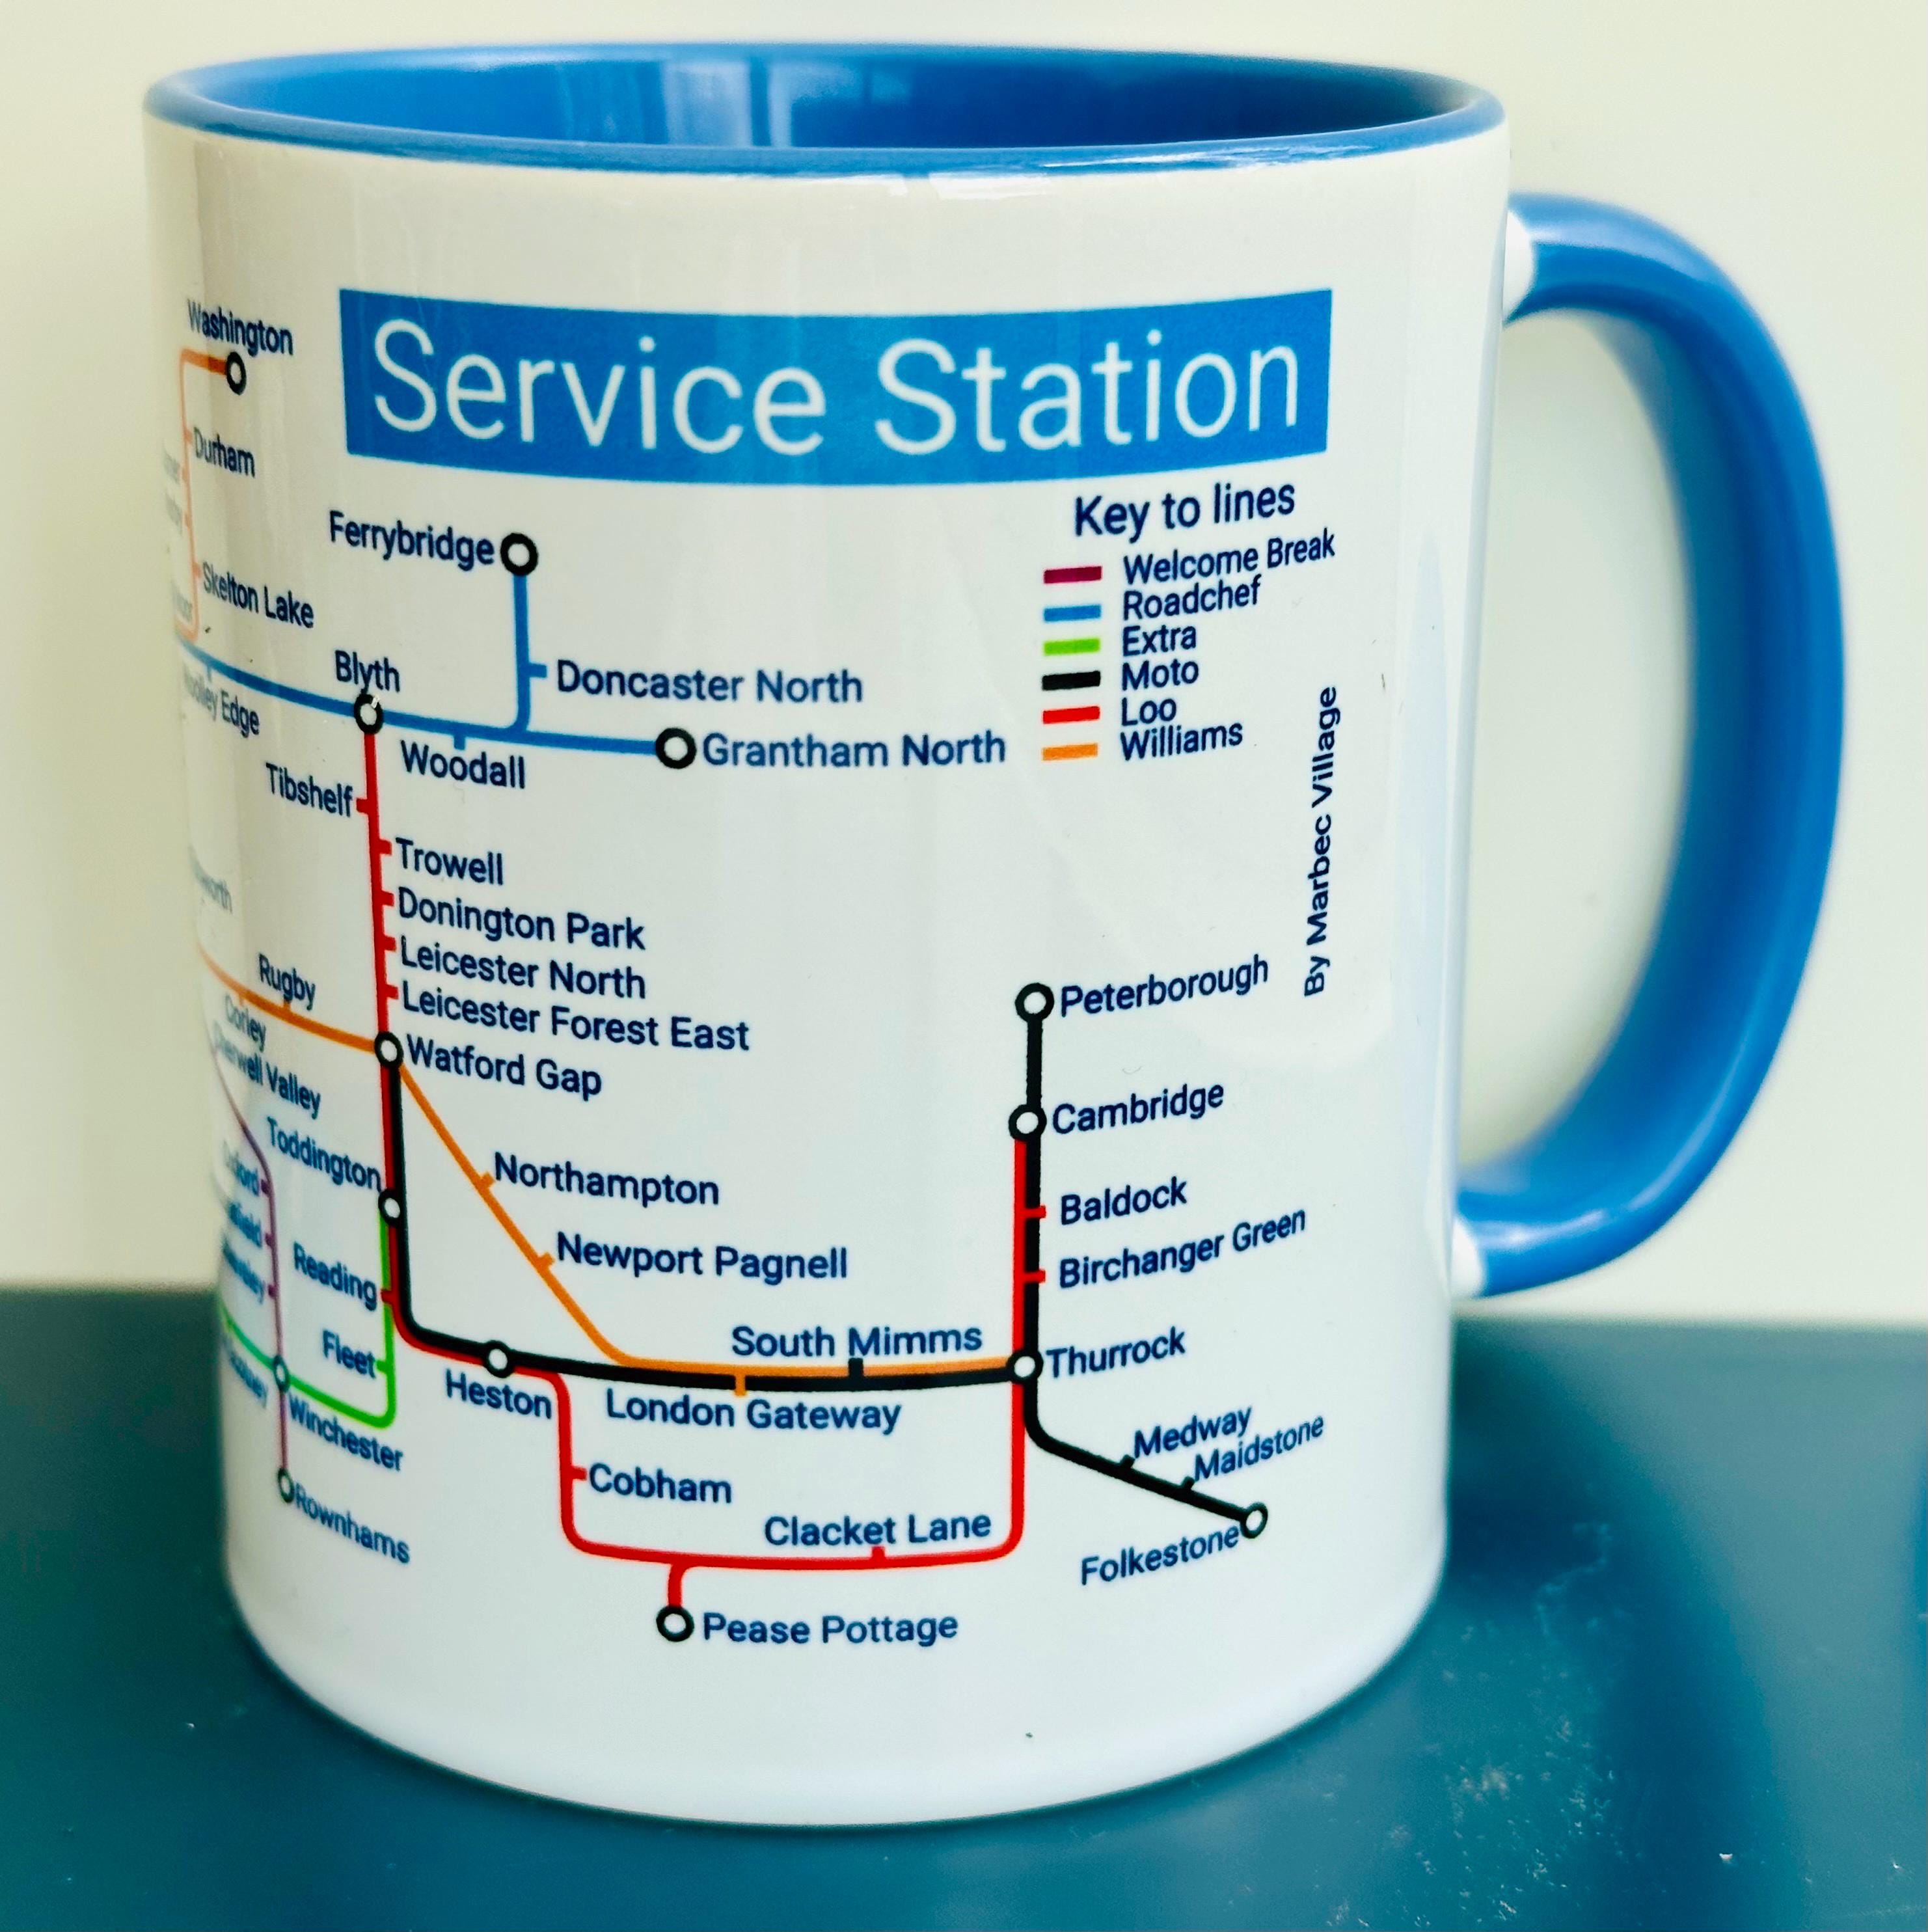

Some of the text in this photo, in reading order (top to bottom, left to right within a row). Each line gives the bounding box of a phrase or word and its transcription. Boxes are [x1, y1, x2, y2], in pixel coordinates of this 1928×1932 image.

[187, 298, 293, 358] Washington
[373, 318, 1300, 456] Service Station
[193, 426, 256, 478] Durham
[329, 510, 495, 571] Ferrybridge
[1074, 482, 1296, 544] Key to lines
[1122, 526, 1336, 585] Welcome Break
[202, 561, 259, 614] Skelton
[264, 584, 314, 629] Lake
[1122, 573, 1262, 621] Roadchef
[1122, 625, 1197, 657] Extra
[334, 649, 401, 695] Blyth
[556, 659, 863, 703] Doncaster North
[1121, 659, 1199, 692] Moto
[220, 687, 260, 739] Edge
[1120, 697, 1177, 727] Loo
[400, 739, 526, 789] Woodall
[702, 729, 1007, 768] Grantham North
[1120, 722, 1244, 761] Williams
[265, 762, 353, 818] Tibshelf
[395, 836, 504, 886] Trowell
[1303, 686, 1341, 998] By Marbec Village
[398, 886, 646, 950] Donington Park
[258, 951, 316, 1011] Rugby
[400, 934, 646, 1000] Leicester North
[1061, 953, 1269, 1018] Peterborough
[402, 979, 750, 1051] Leicester Forest East
[265, 1061, 321, 1120] Valley
[406, 1033, 603, 1102] Watford Gap
[1052, 1083, 1225, 1135] Cambridge
[267, 1115, 383, 1193] Toddington
[494, 1151, 720, 1208] Northampton
[1060, 1175, 1188, 1225] Baldock
[557, 1231, 849, 1286] Newport Pagnell
[1059, 1208, 1306, 1288] Birchanger Green
[293, 1240, 378, 1313] Reading
[322, 1329, 376, 1379] Fleet
[731, 1325, 983, 1357] South Mimms
[1046, 1326, 1187, 1380] Thurrock
[444, 1369, 552, 1419] Heston
[606, 1387, 902, 1435] London Gateway
[288, 1392, 404, 1472] Winchester
[1133, 1405, 1253, 1459] Medway
[1193, 1415, 1325, 1482] Maidstone
[588, 1462, 733, 1504] Cobham
[294, 1482, 411, 1565] Rownhams
[764, 1512, 992, 1547] Clacket Lane
[1080, 1525, 1240, 1586] Folkestone
[702, 1612, 958, 1648] Pease Pottage
